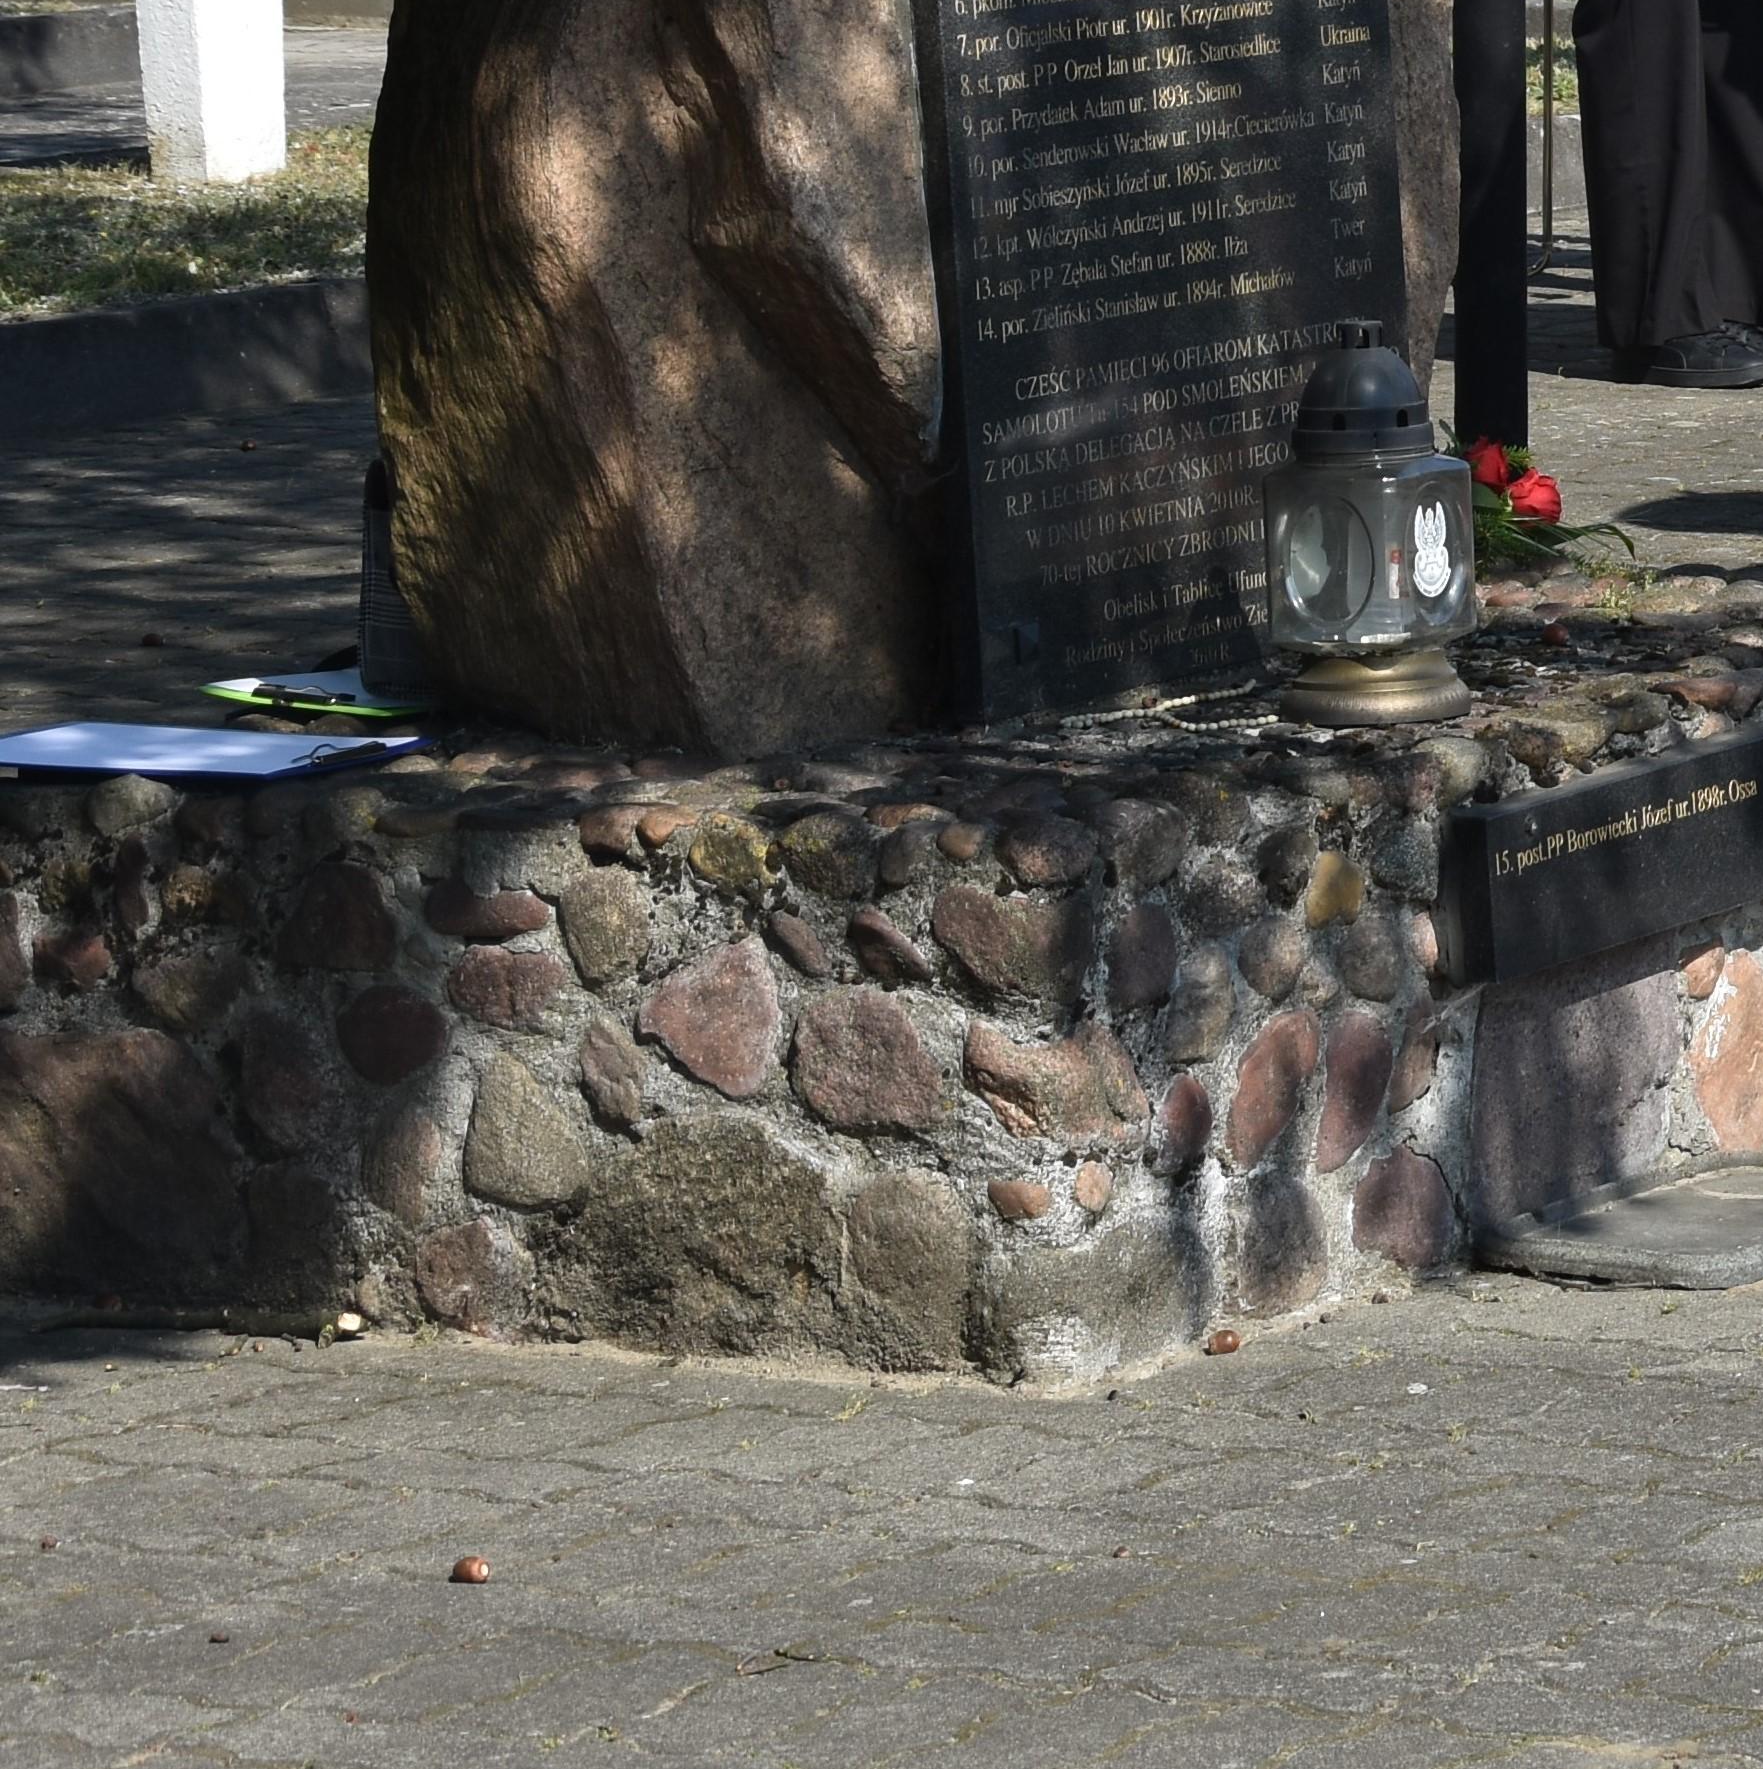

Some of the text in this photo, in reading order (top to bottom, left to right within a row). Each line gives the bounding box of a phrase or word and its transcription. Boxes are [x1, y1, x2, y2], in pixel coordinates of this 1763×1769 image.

[956, 32, 972, 57] 7.
[974, 34, 1002, 60] por.
[1005, 19, 1072, 55] Oficjalski
[1075, 15, 1110, 41] Piotr
[1111, 18, 1130, 36] ur.
[1135, 6, 1176, 33] 1901r.
[959, 73, 973, 97] 8.
[977, 72, 993, 95] st.
[996, 68, 1030, 99] post.
[1063, 55, 1102, 83] Orzeł
[1105, 52, 1128, 77] Jan
[1132, 54, 1150, 73] ur.
[1155, 43, 1196, 70] 1907r.
[1199, 31, 1281, 64] Starosiedlice
[1319, 18, 1370, 47] Ukraina
[962, 58, 1361, 142] 9. por. Przydatek Adam ur. 1893r. Sienno Katyń
[1014, 363, 1072, 402] CZEŚĆ
[1151, 350, 1169, 375] 96
[1172, 335, 1252, 372] OFIAROM
[1495, 850, 1514, 876] 15.
[1568, 807, 1637, 854] Borowiecki
[1640, 797, 1672, 831] Józef
[1729, 778, 1757, 808] Ossa
